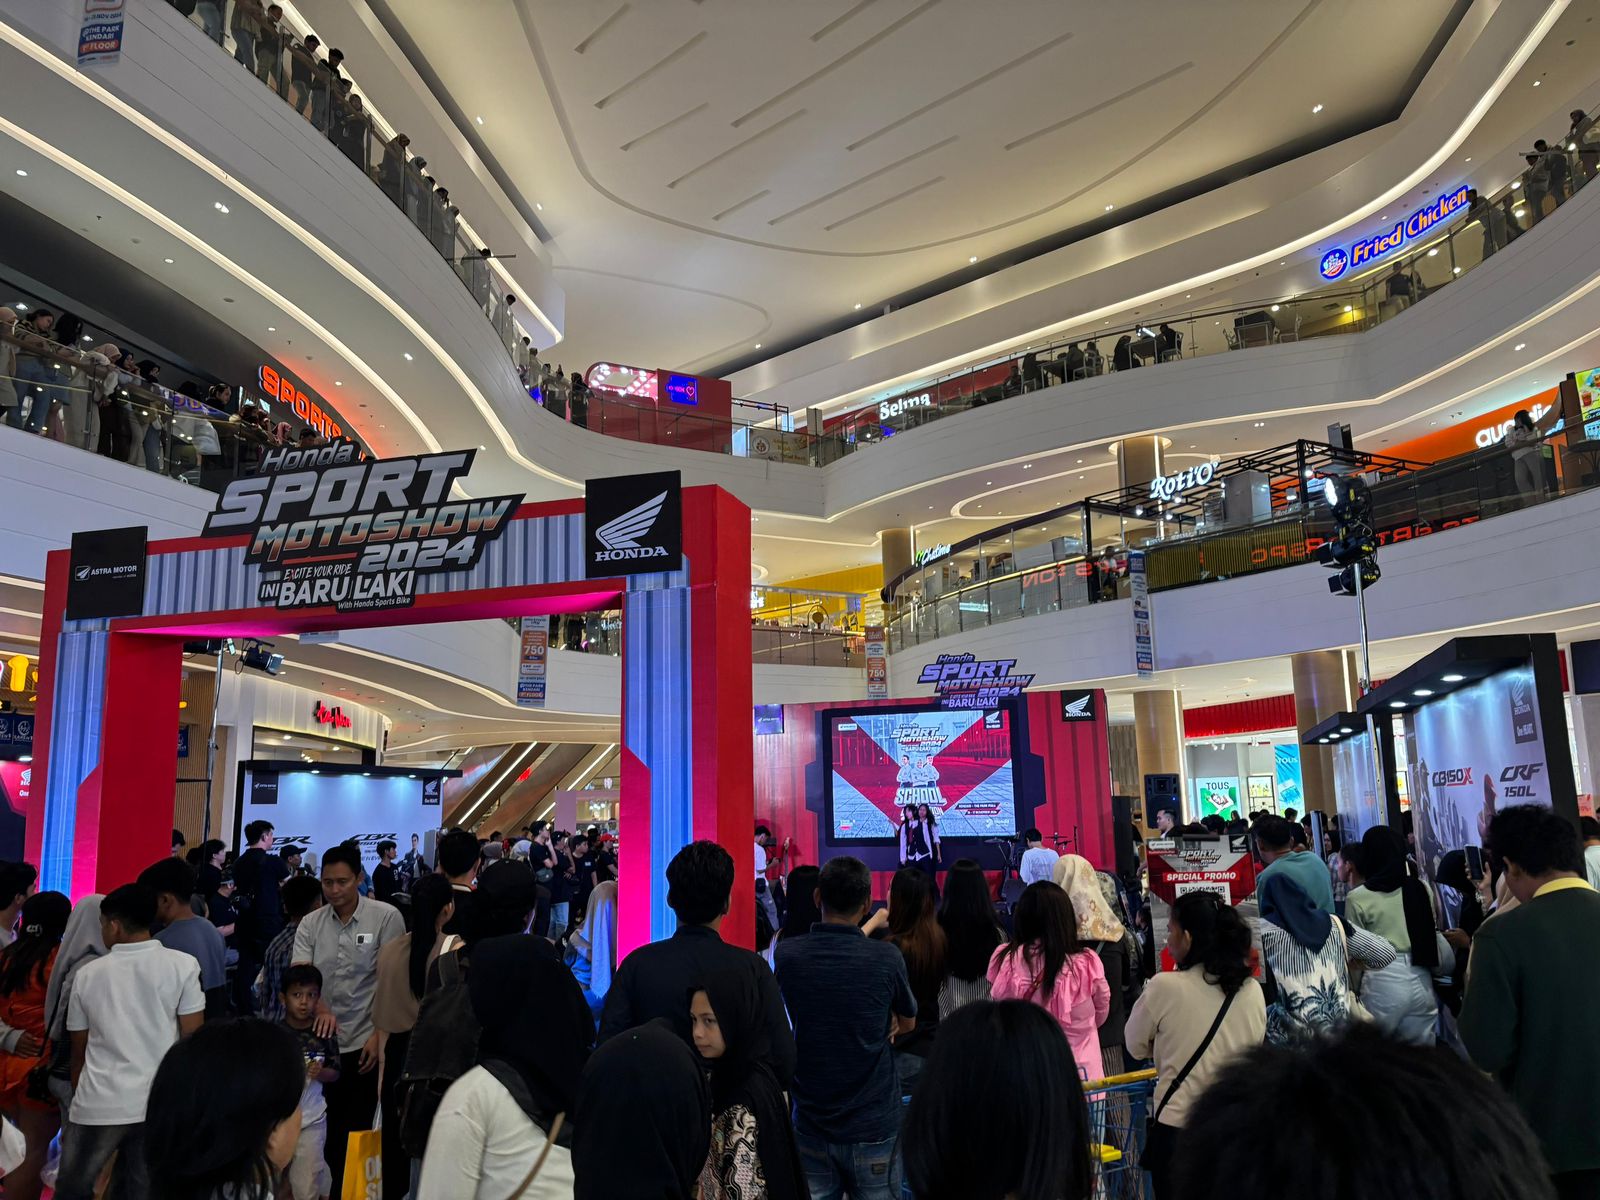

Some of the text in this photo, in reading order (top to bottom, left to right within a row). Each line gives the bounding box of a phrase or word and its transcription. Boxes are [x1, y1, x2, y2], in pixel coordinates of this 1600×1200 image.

[1352, 223, 1402, 266] Fried
[1406, 187, 1468, 237] Chicken
[879, 393, 931, 420] Selma
[261, 440, 354, 473] Honda
[209, 453, 468, 529] SPORT
[251, 499, 513, 563] MOTOSHOW
[357, 535, 476, 573] 2024
[595, 545, 669, 562] HONDA
[91, 565, 137, 576] ASTRA MOTOR
[284, 563, 352, 583] EXCITE YOUR RIDE
[261, 571, 415, 607] INI BARU LAKI
[338, 596, 411, 609] With Honda Sports Bike
[523, 645, 545, 655] 750
[868, 669, 885, 678] 750
[919, 660, 1014, 682] SPORT
[936, 675, 1032, 693] MOTOSHOW
[977, 687, 1021, 698] 2024
[948, 697, 976, 708] BARU
[976, 696, 999, 706] LAKI
[1514, 703, 1531, 716] HONDA
[891, 727, 939, 738] SPORT
[1432, 767, 1474, 787] CB150X
[1500, 762, 1544, 782] CRF
[1206, 782, 1230, 791] TOUS
[1504, 785, 1537, 797] 150L
[896, 787, 946, 805] SCHOOL
[1167, 872, 1237, 881] SPECIAL PROMO
